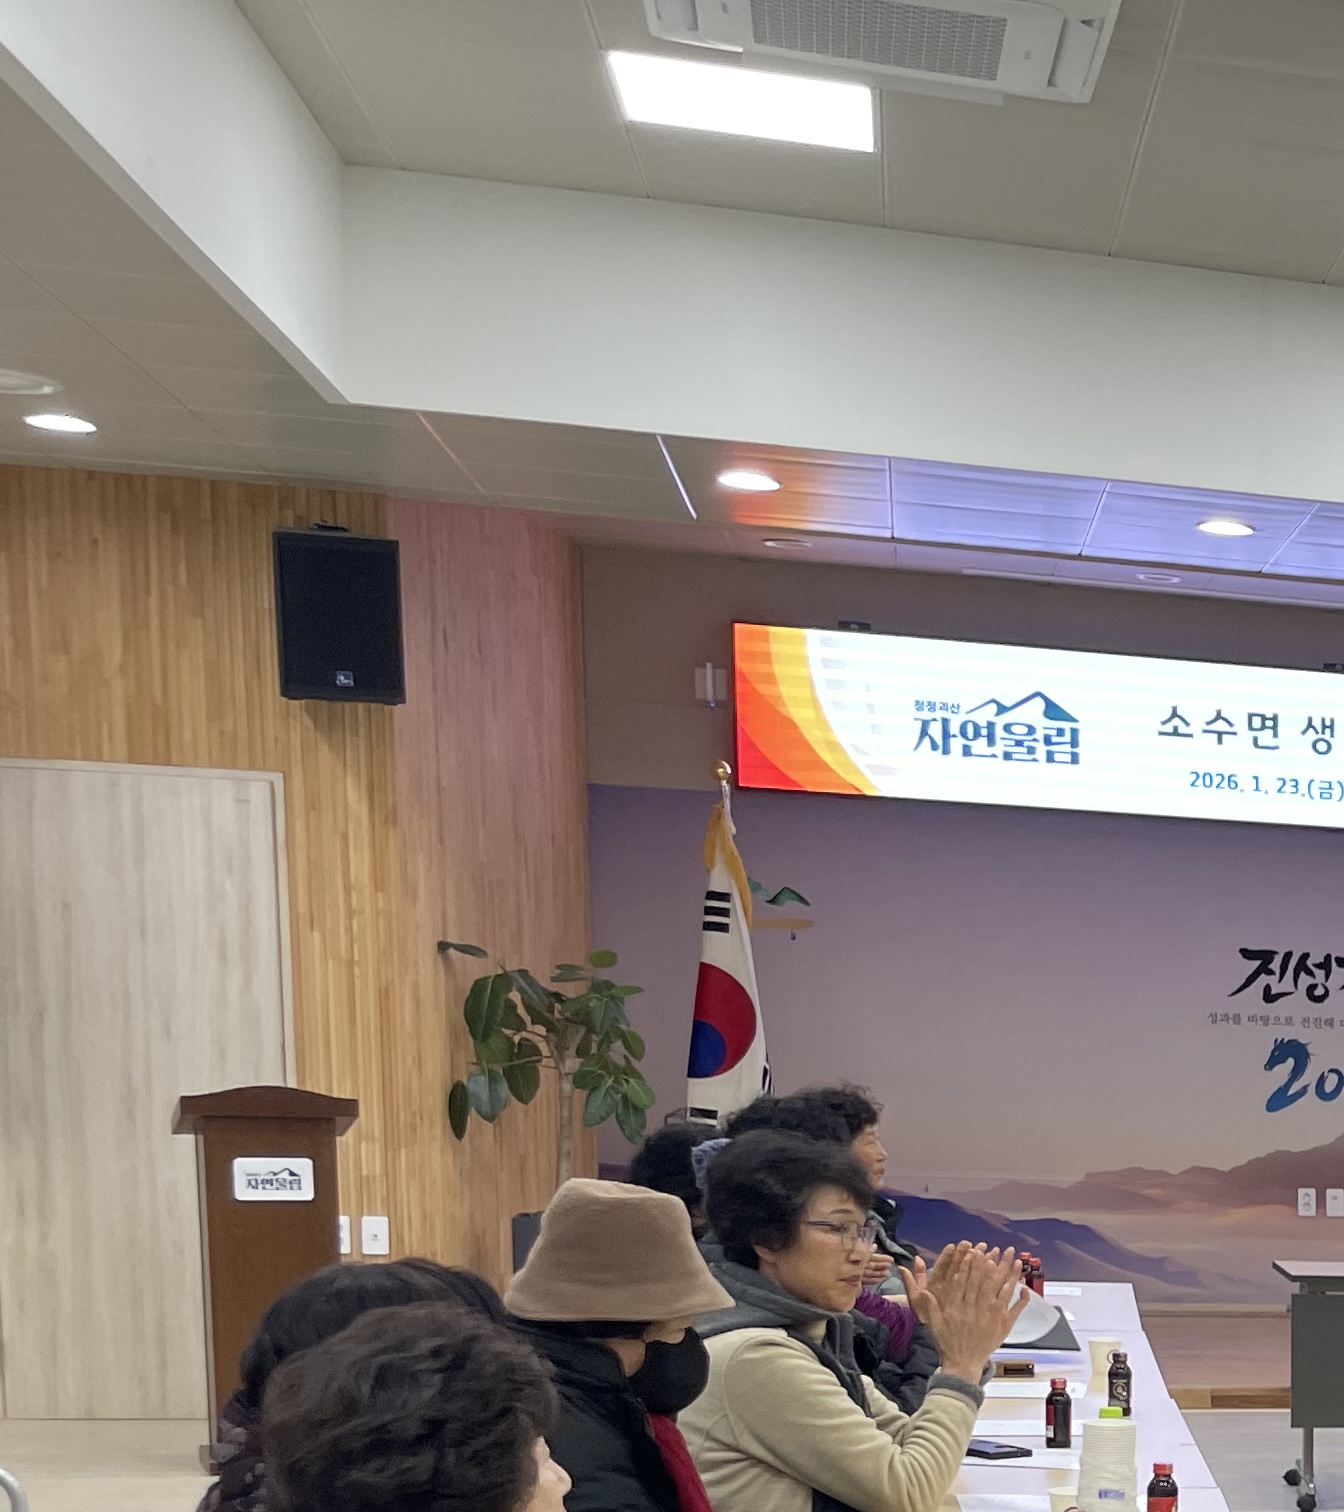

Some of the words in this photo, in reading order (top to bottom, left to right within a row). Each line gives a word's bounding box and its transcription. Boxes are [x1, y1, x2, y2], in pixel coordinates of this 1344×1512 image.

[914, 699, 961, 714] 청정괴산
[913, 716, 1080, 765] 자연울림
[1157, 705, 1281, 751] 소수면
[1189, 771, 1244, 793] 2026.
[1252, 775, 1269, 794] 1.
[1276, 777, 1344, 802] 23.(금)
